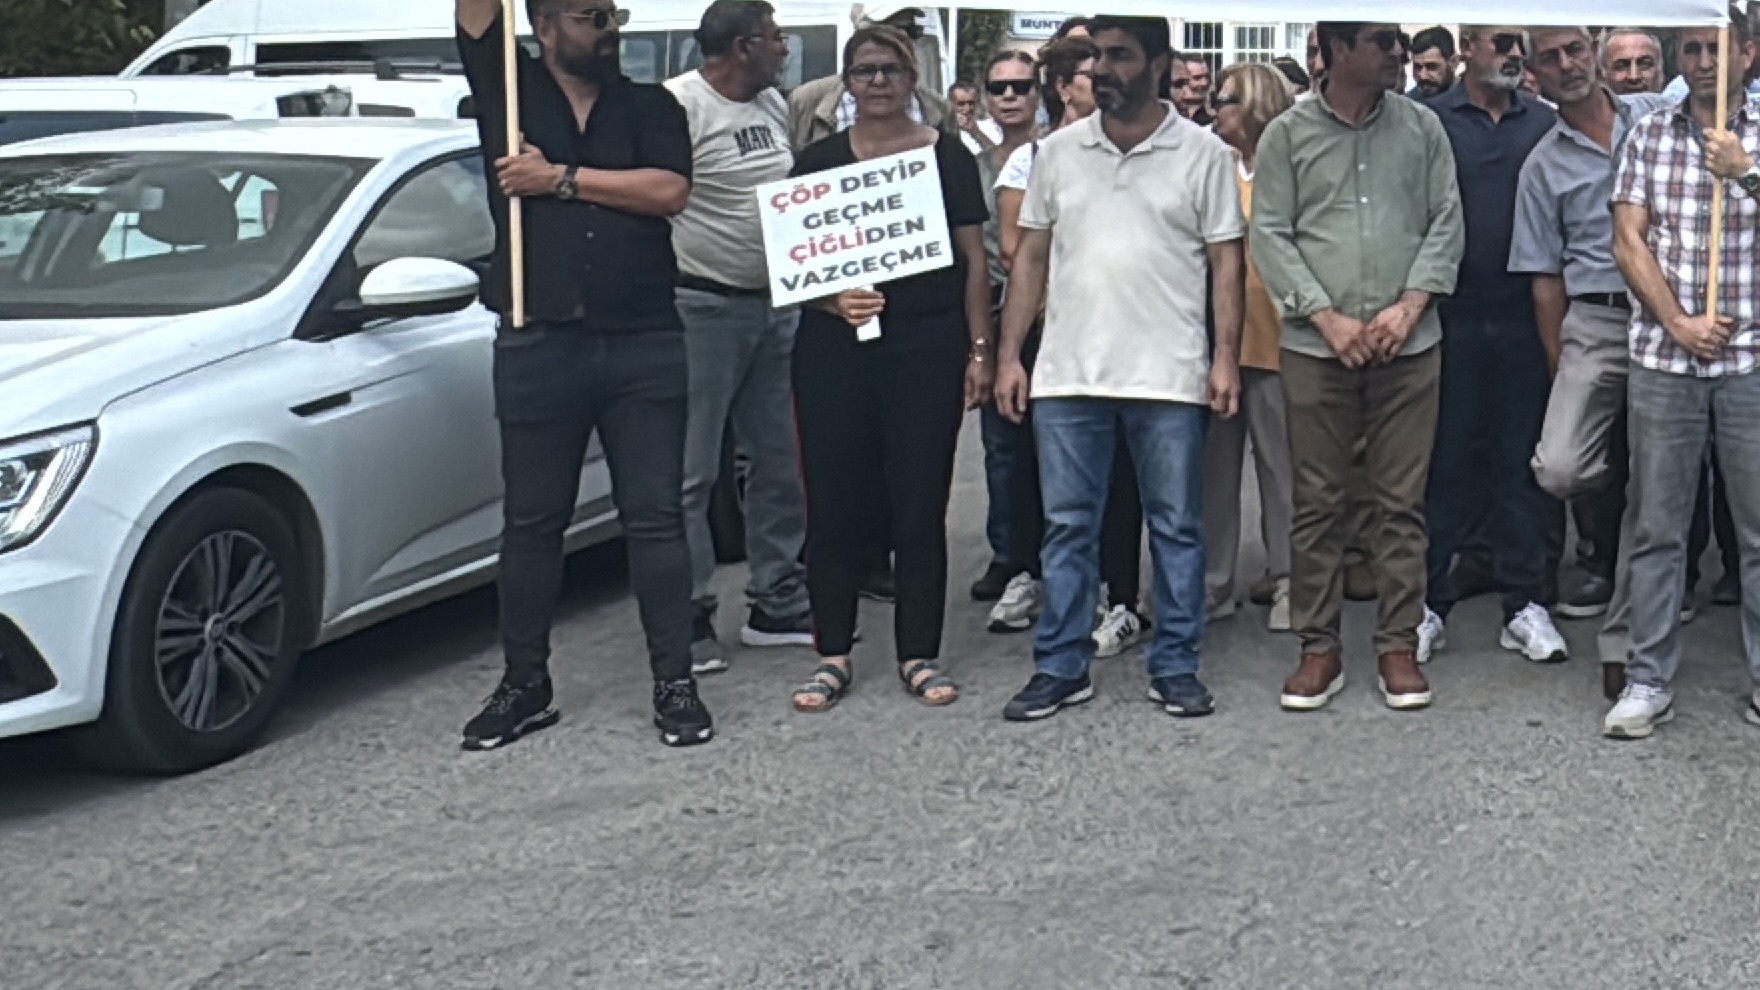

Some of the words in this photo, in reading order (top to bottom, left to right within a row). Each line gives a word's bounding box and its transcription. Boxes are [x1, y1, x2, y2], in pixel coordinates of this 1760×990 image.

[770, 183, 832, 214] ÇÖP
[840, 159, 927, 194] DEYİP
[802, 193, 904, 226] GEÇME
[788, 214, 926, 265] ÇİĞLİDEN
[779, 240, 943, 292] VAZGEÇME
